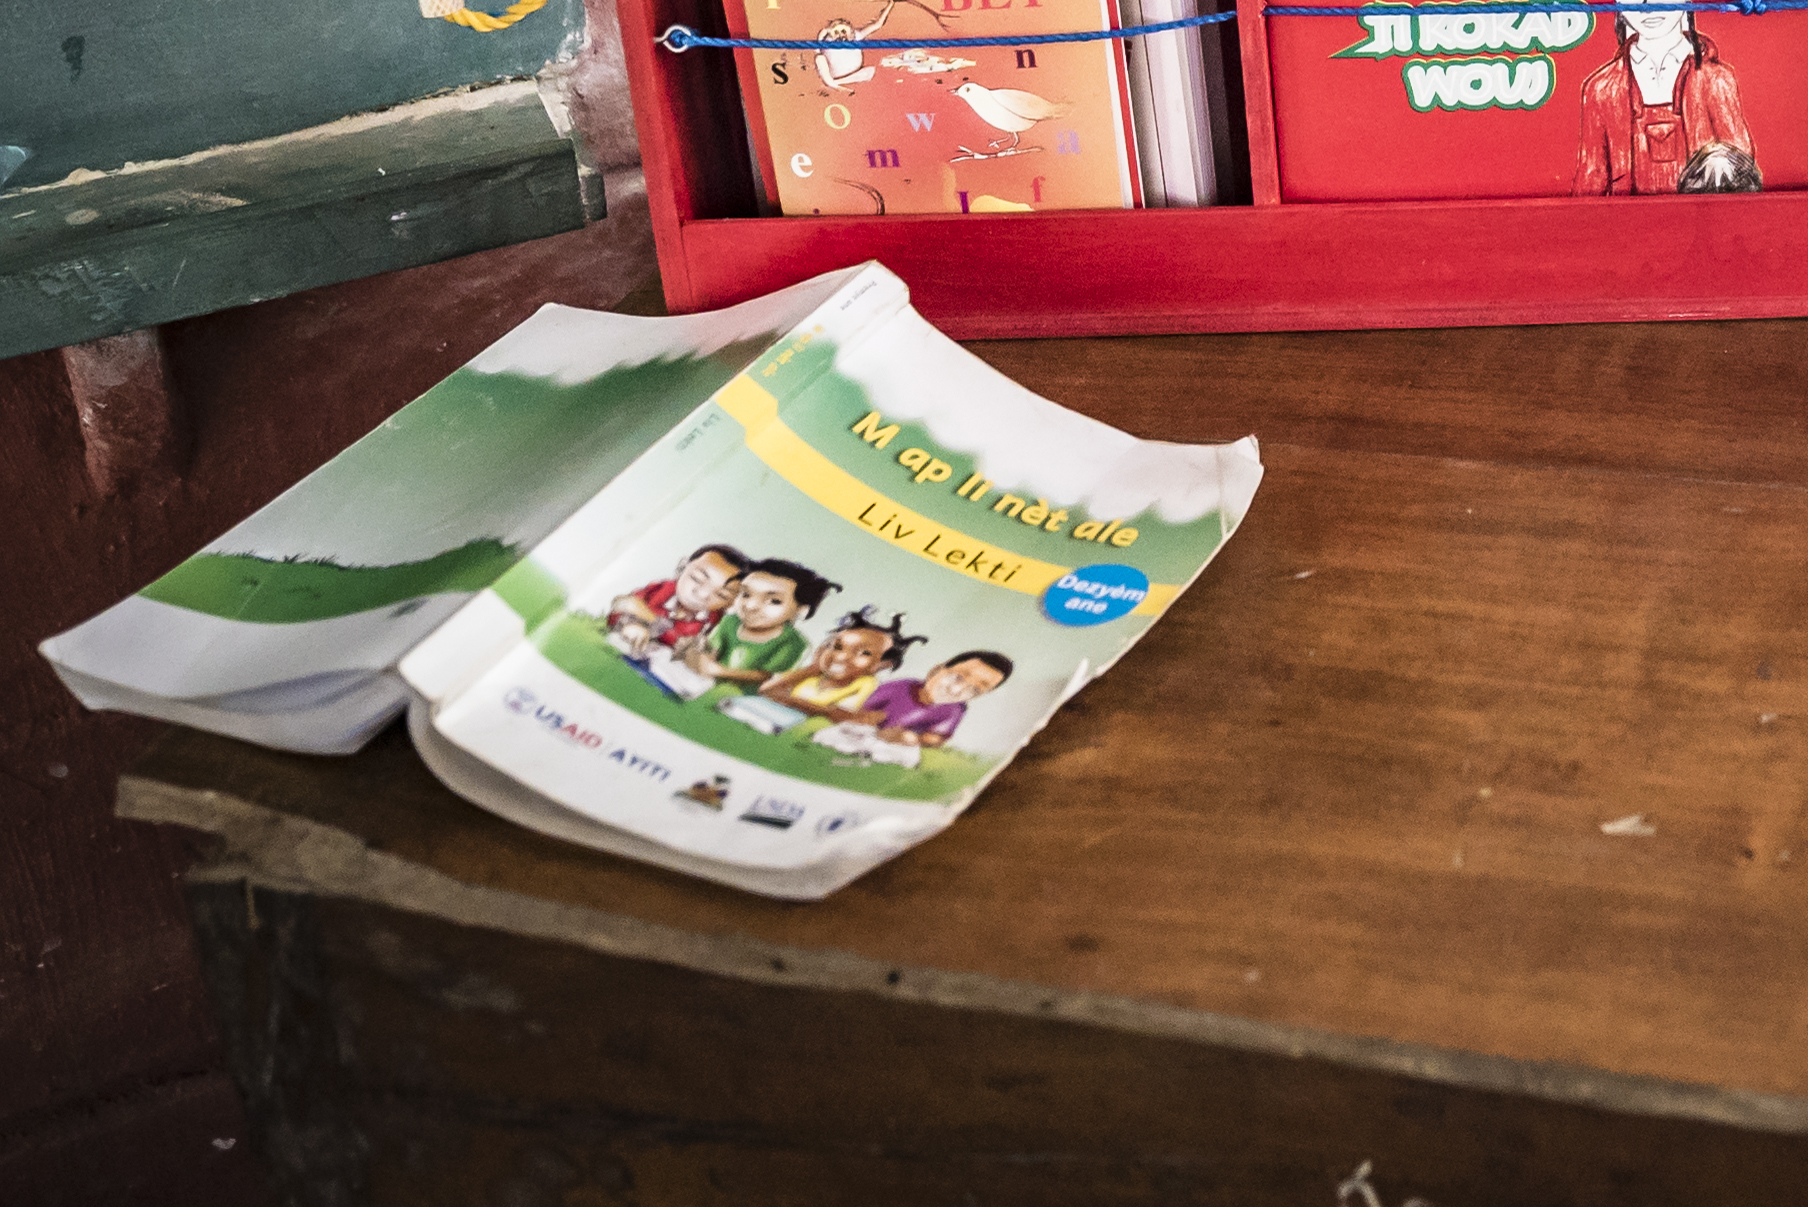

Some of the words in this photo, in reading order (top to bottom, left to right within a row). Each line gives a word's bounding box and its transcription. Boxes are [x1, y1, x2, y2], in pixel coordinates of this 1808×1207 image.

[1014, 47, 1038, 70] n
[790, 152, 815, 178] e
[866, 148, 902, 169] m
[851, 411, 901, 449] M
[898, 447, 953, 483] ap
[957, 472, 995, 502] li
[994, 493, 1069, 532] nèt
[1072, 519, 1139, 548] ale
[857, 502, 915, 540] Liv
[923, 533, 1023, 583] Lekti
